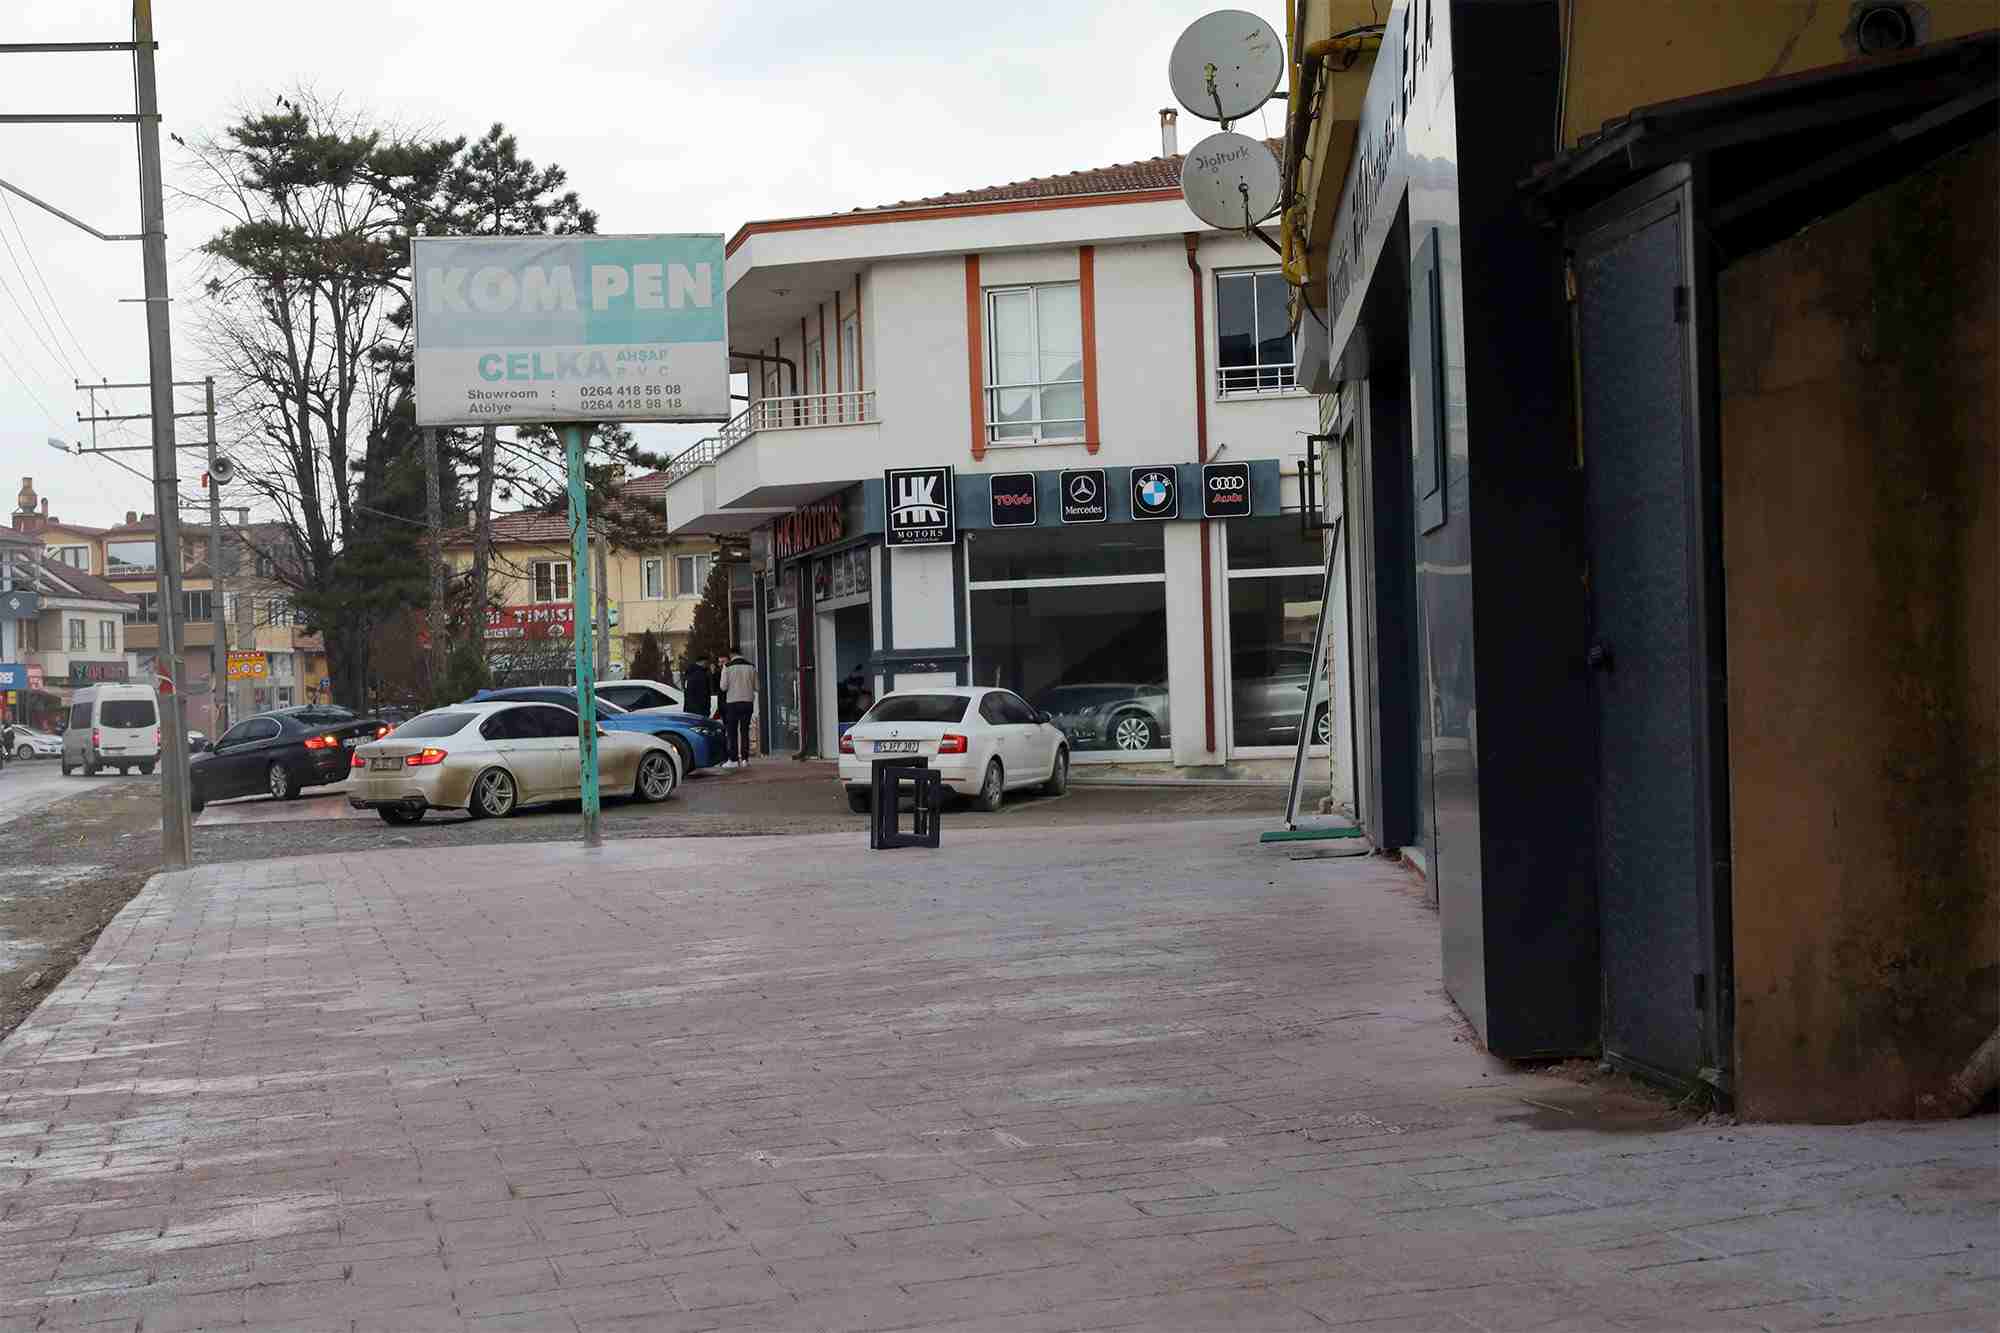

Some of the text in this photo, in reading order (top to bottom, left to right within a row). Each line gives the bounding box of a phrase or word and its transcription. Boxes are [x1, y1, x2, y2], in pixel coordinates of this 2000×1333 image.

[479, 351, 611, 382] CELKA
[467, 389, 538, 400] Showroom
[580, 385, 613, 397] 0264
[616, 385, 641, 396] 418
[646, 384, 662, 395] 56
[666, 383, 681, 395] 08
[581, 399, 613, 410] 0264
[617, 399, 641, 409] 418
[667, 398, 682, 408] 18
[899, 475, 941, 525] HK
[1065, 505, 1103, 515] Mercedes
[897, 528, 943, 538] MOTORS
